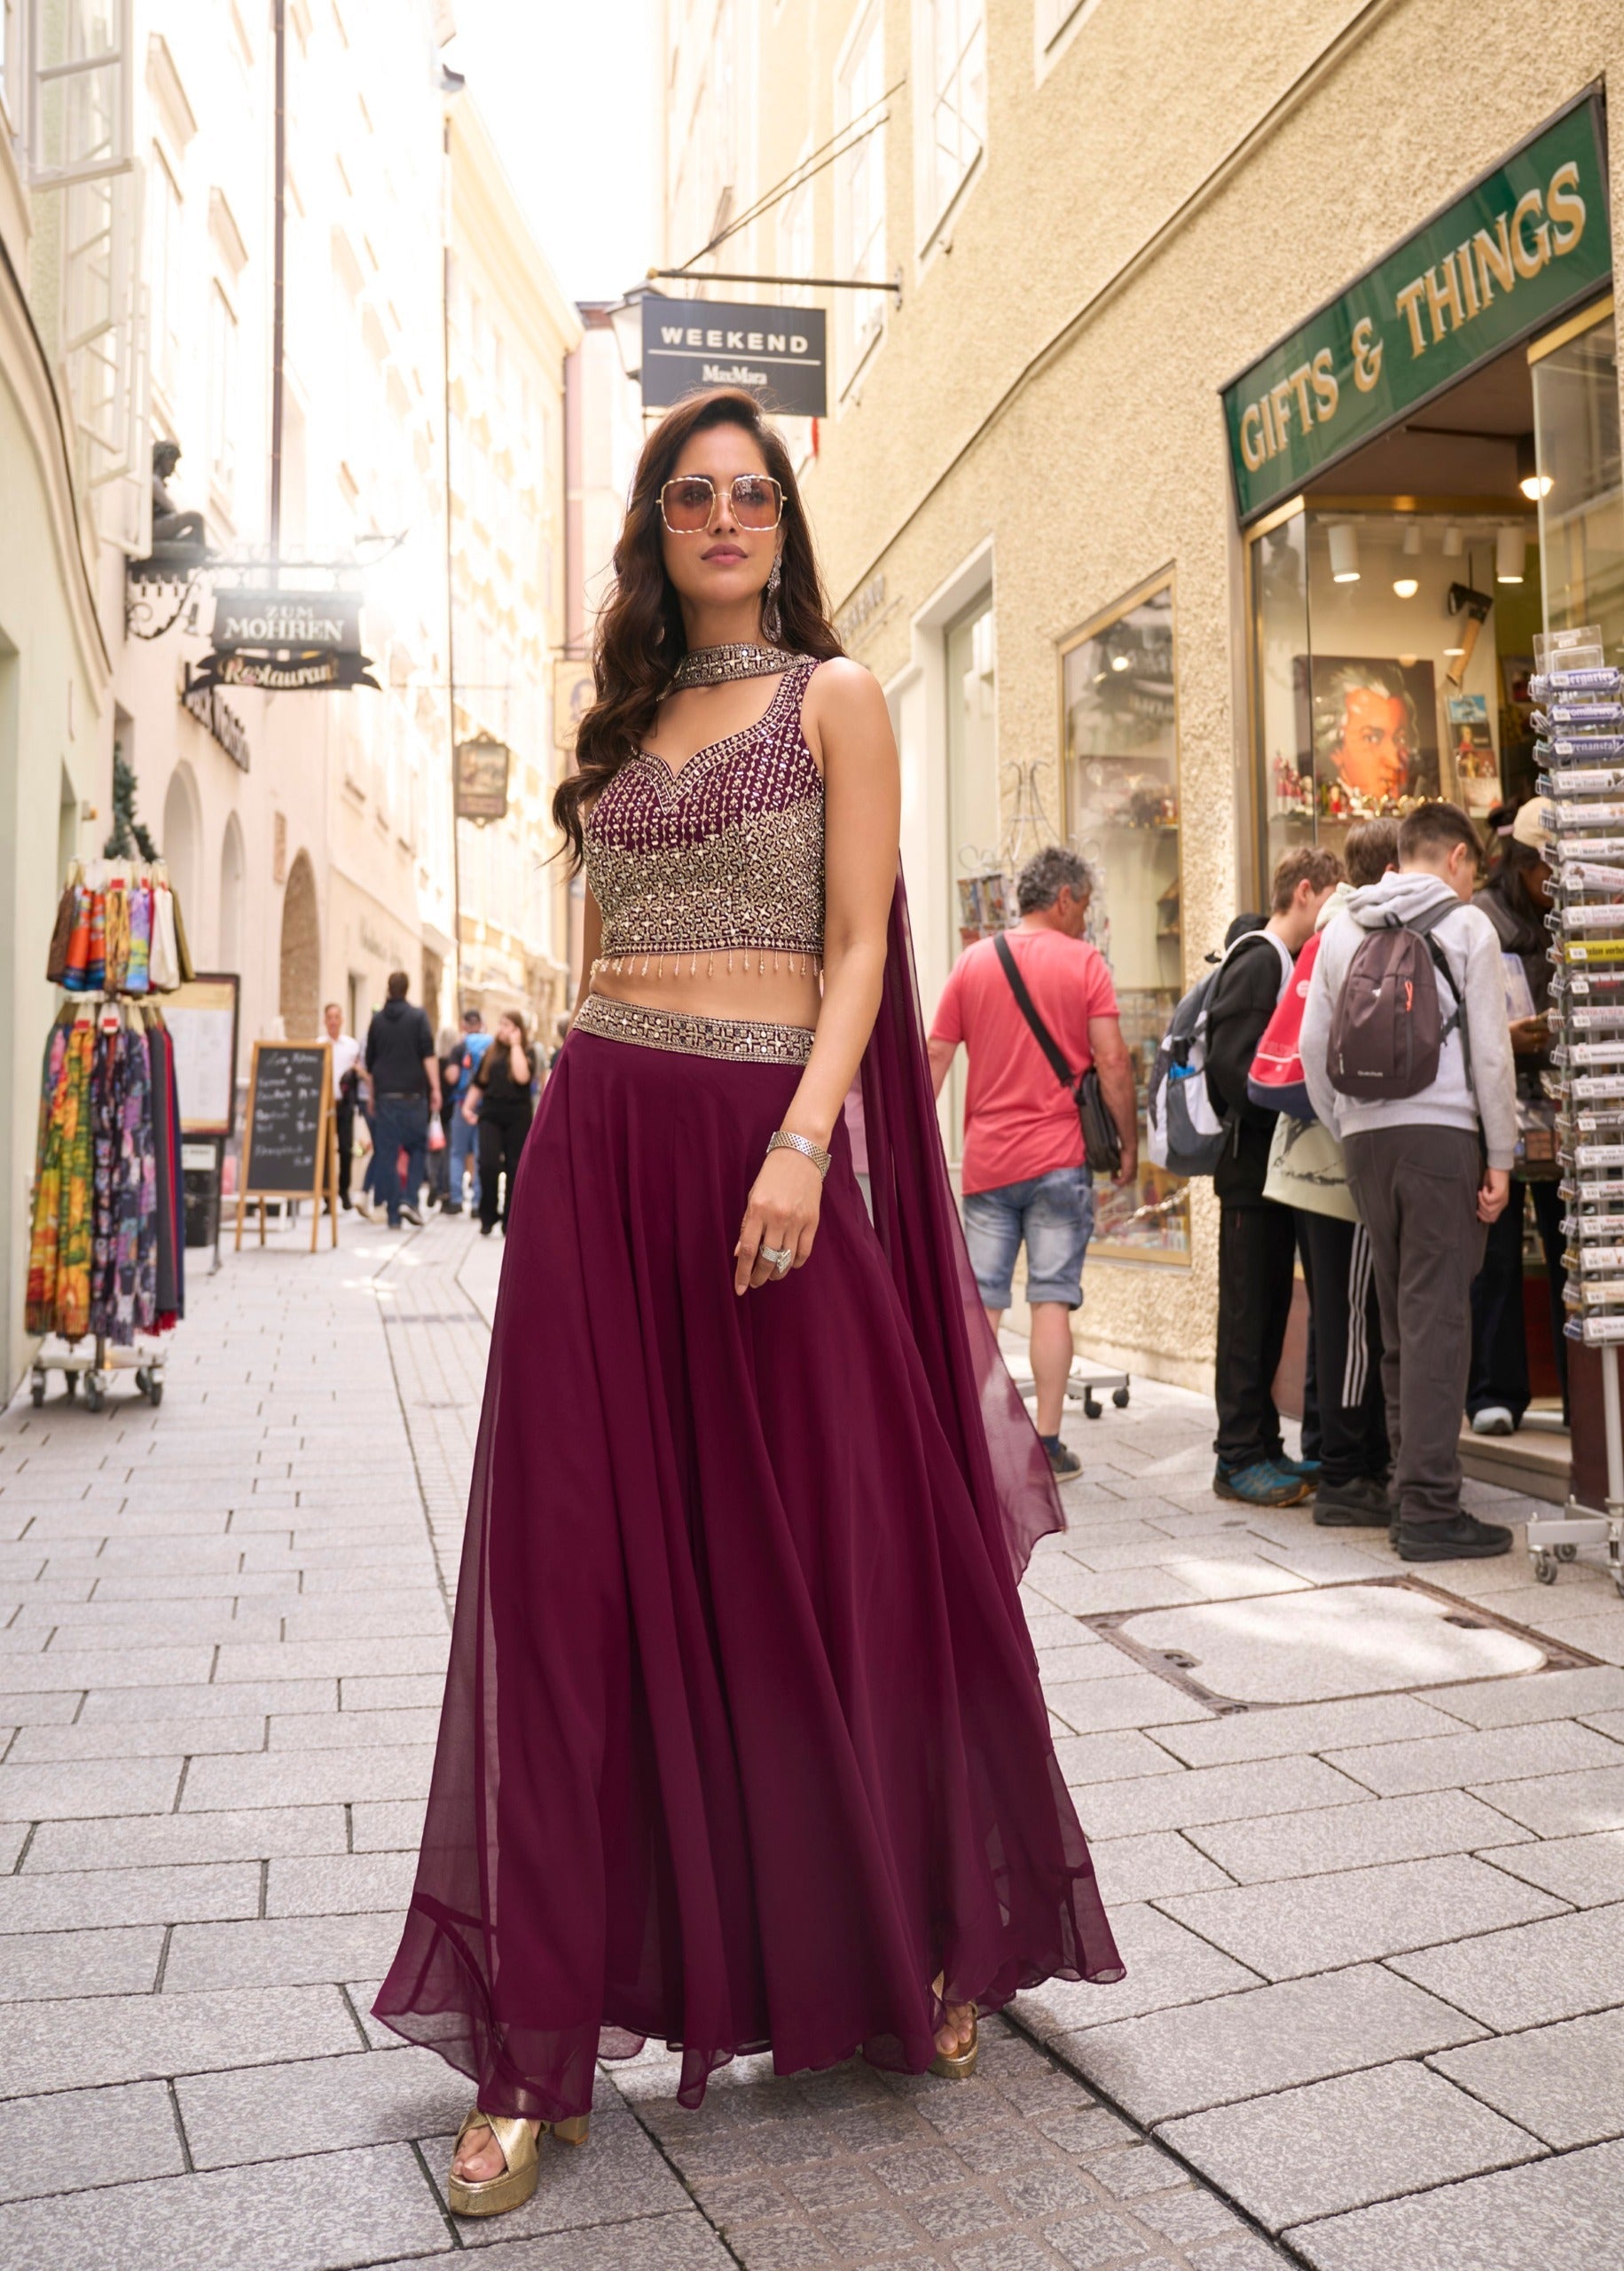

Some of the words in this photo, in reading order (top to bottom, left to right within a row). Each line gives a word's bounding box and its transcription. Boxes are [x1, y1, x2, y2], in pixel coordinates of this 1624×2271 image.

[1240, 348, 1339, 473] GIFTS
[1351, 317, 1384, 392] &
[1396, 161, 1586, 359] THINGS
[661, 326, 809, 353] WEEKEND
[266, 605, 314, 619] ZUM
[224, 617, 344, 640] MOHREN
